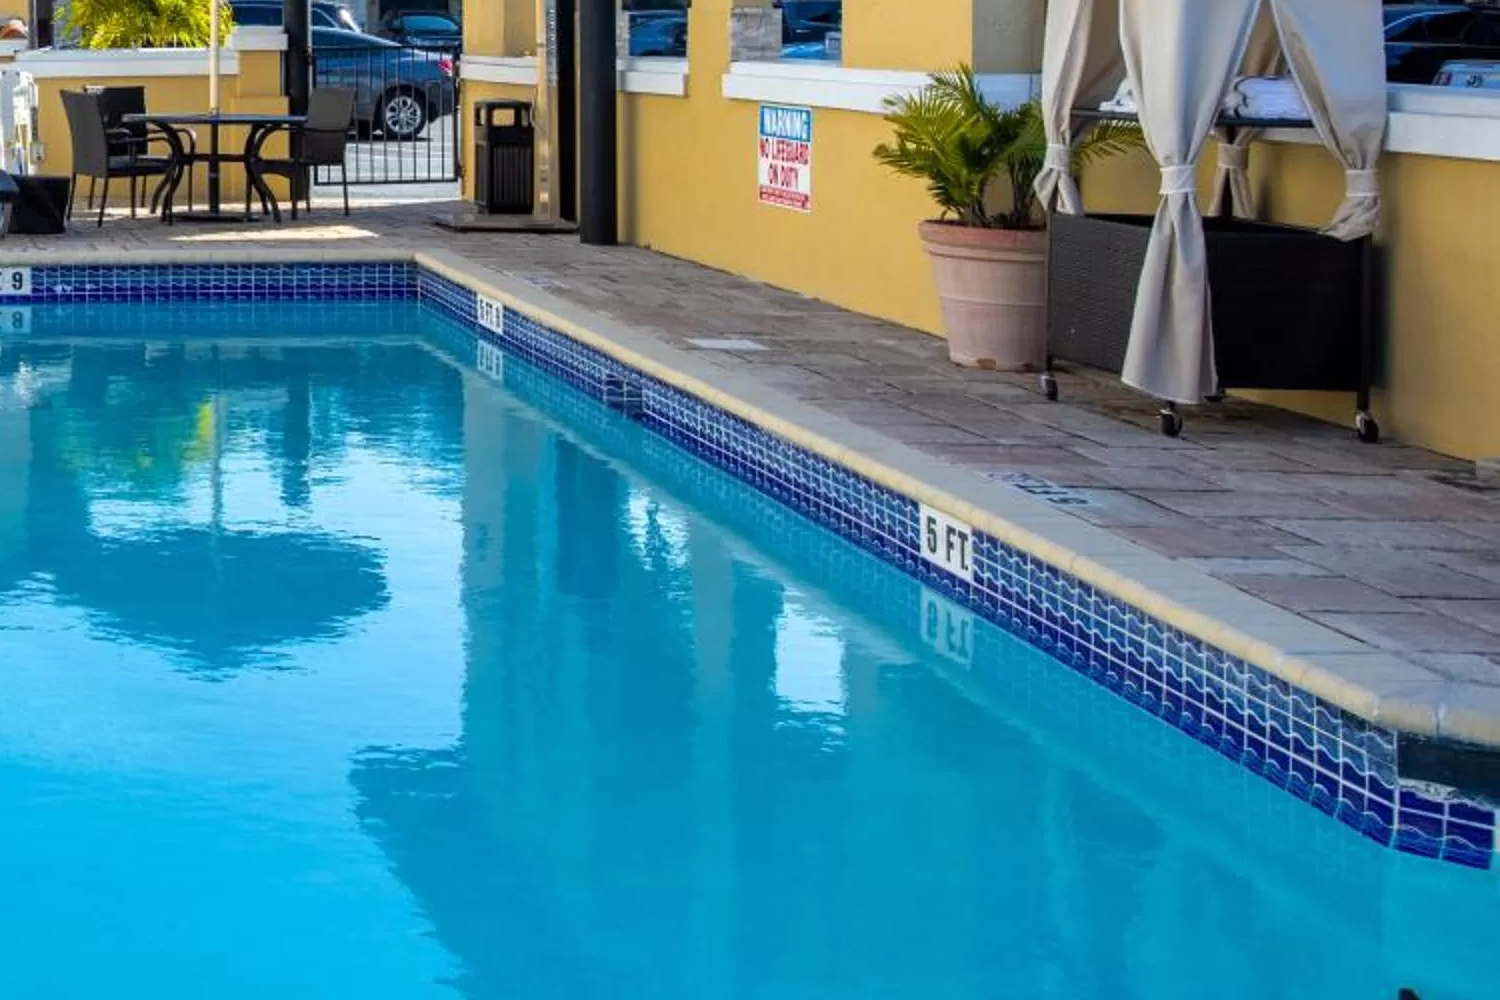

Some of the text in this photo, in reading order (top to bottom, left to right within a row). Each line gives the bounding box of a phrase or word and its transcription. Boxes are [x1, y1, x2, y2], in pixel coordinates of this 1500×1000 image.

[763, 107, 810, 140] WARNING
[760, 138, 809, 166] NO LIFEGUARD
[768, 163, 799, 190] ON DUTY
[11, 271, 24, 291] 9
[926, 515, 937, 554] 5
